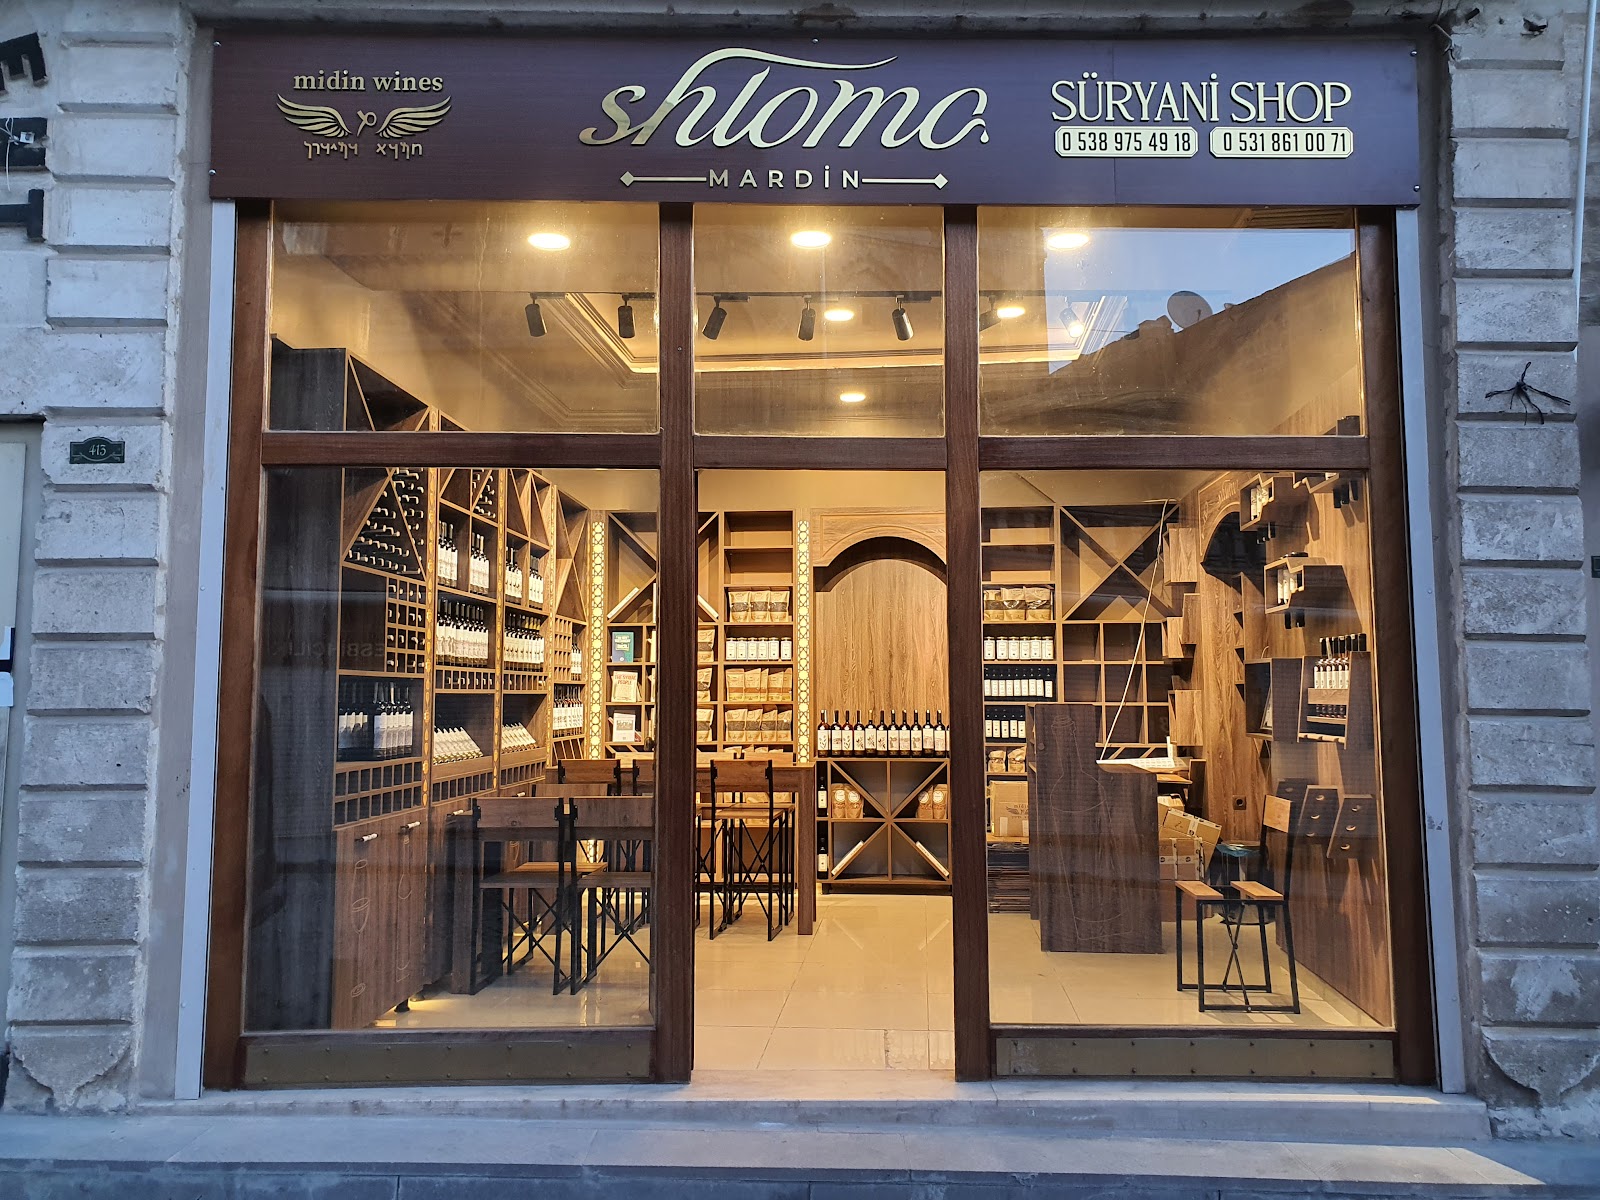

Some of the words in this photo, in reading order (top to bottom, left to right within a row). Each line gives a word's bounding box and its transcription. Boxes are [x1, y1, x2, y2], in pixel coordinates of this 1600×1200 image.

[293, 70, 366, 91] midin
[373, 70, 444, 92] wines
[1051, 72, 1220, 122] SÜRYANİ
[1230, 81, 1352, 123] SHOP
[1062, 132, 1071, 151] 0
[1078, 132, 1108, 152] 538
[1114, 132, 1143, 152] 975
[1148, 132, 1168, 152] 49
[1174, 132, 1191, 152] 18
[1223, 132, 1233, 152] 0
[1239, 132, 1265, 152] 531
[1272, 132, 1299, 152] 861
[1305, 132, 1326, 152] 00
[1331, 132, 1346, 152] 71
[709, 165, 860, 189] MARDİN
